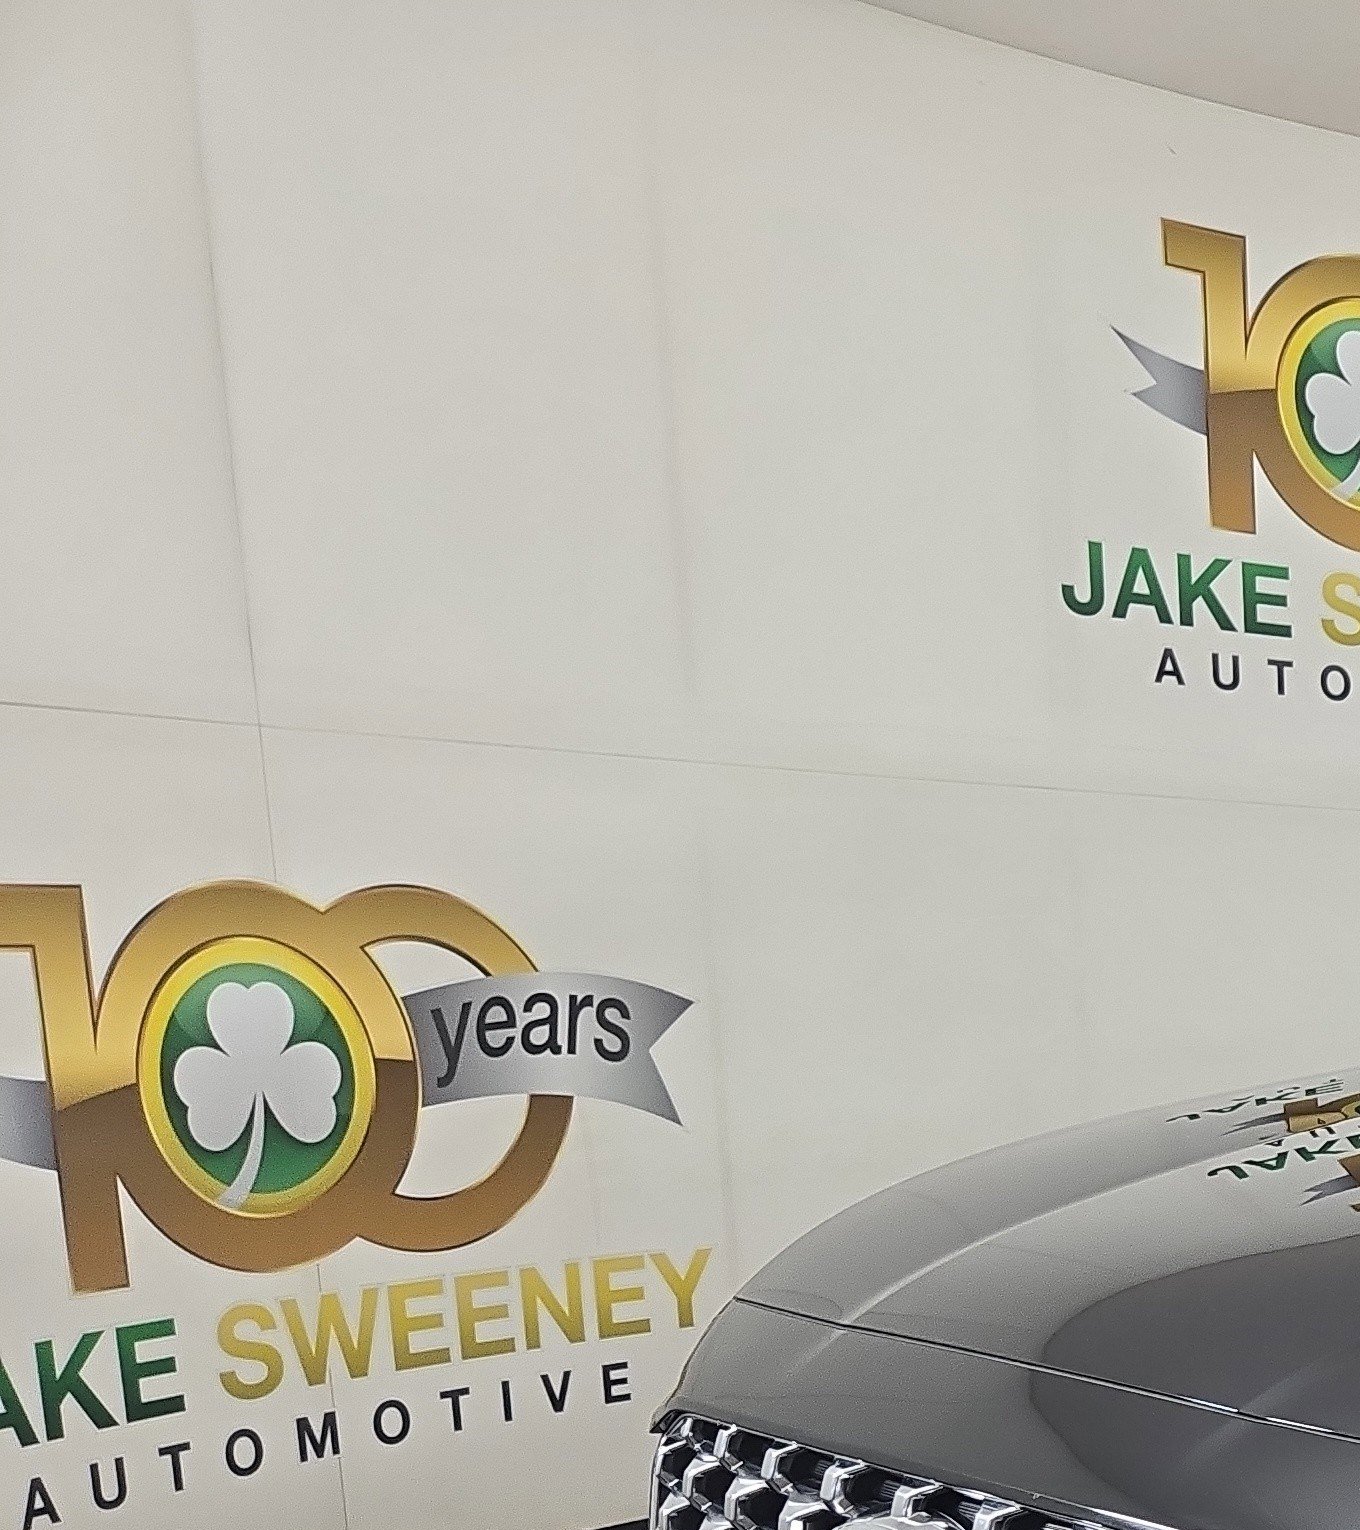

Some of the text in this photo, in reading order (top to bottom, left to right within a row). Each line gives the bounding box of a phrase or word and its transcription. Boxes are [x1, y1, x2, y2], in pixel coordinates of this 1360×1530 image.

[1061, 541, 1292, 638] JAKE
[0, 879, 632, 1295] 100 years
[0, 1248, 713, 1447] KE SWEENEY
